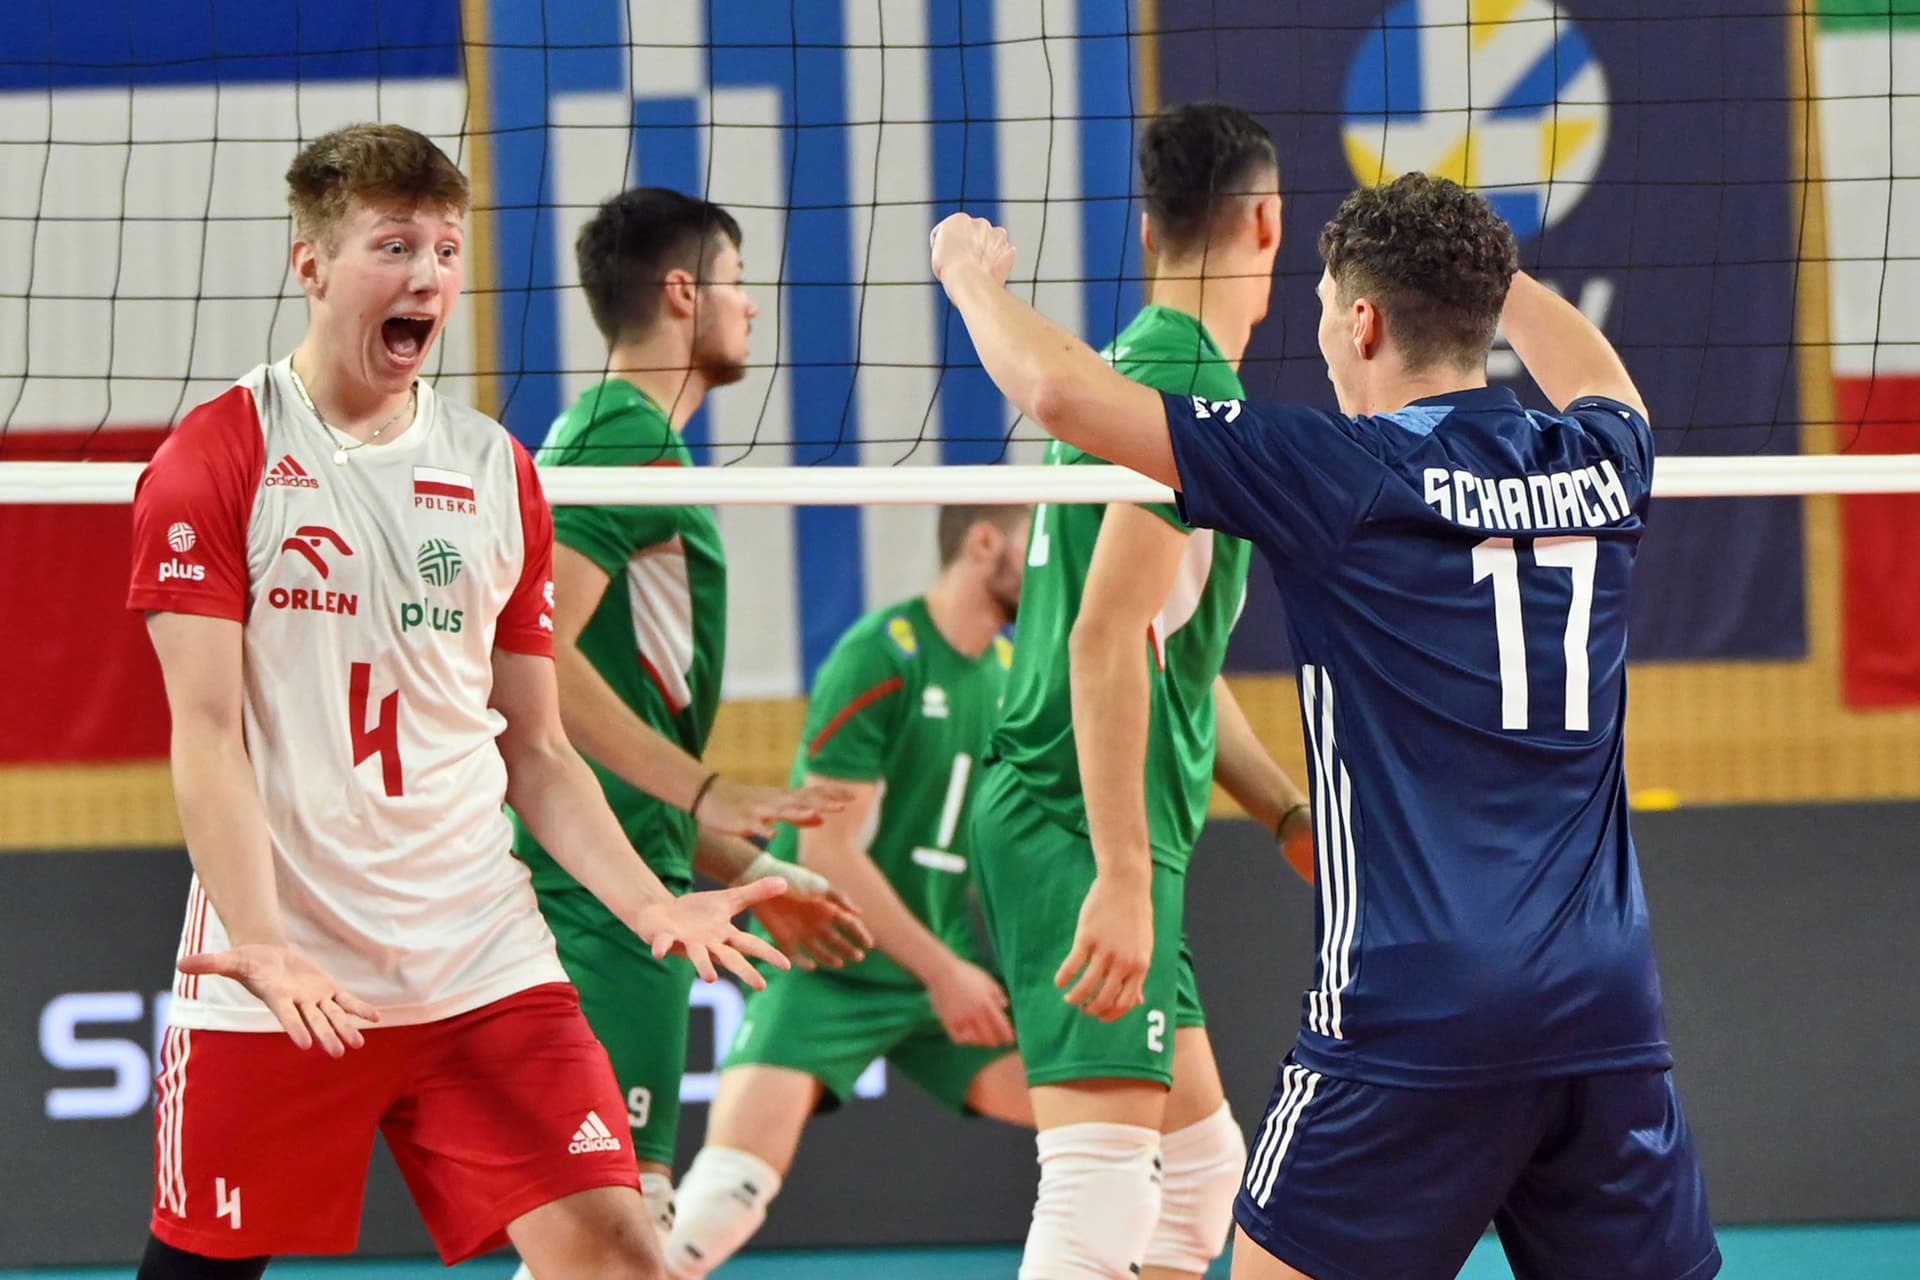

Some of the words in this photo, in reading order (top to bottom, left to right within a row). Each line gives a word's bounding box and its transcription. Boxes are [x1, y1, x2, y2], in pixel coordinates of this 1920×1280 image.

[265, 474, 319, 488] adidas
[1423, 459, 1631, 530] SCHADACH
[414, 497, 477, 514] POLSKA
[159, 559, 205, 581] plus
[268, 587, 358, 616] ORLEN
[1471, 537, 1598, 731] 17
[348, 662, 403, 797] 4
[1147, 1009, 1165, 1053] 2
[627, 1086, 651, 1128] 9
[568, 1136, 621, 1154] adidas
[215, 1177, 241, 1230] 4
